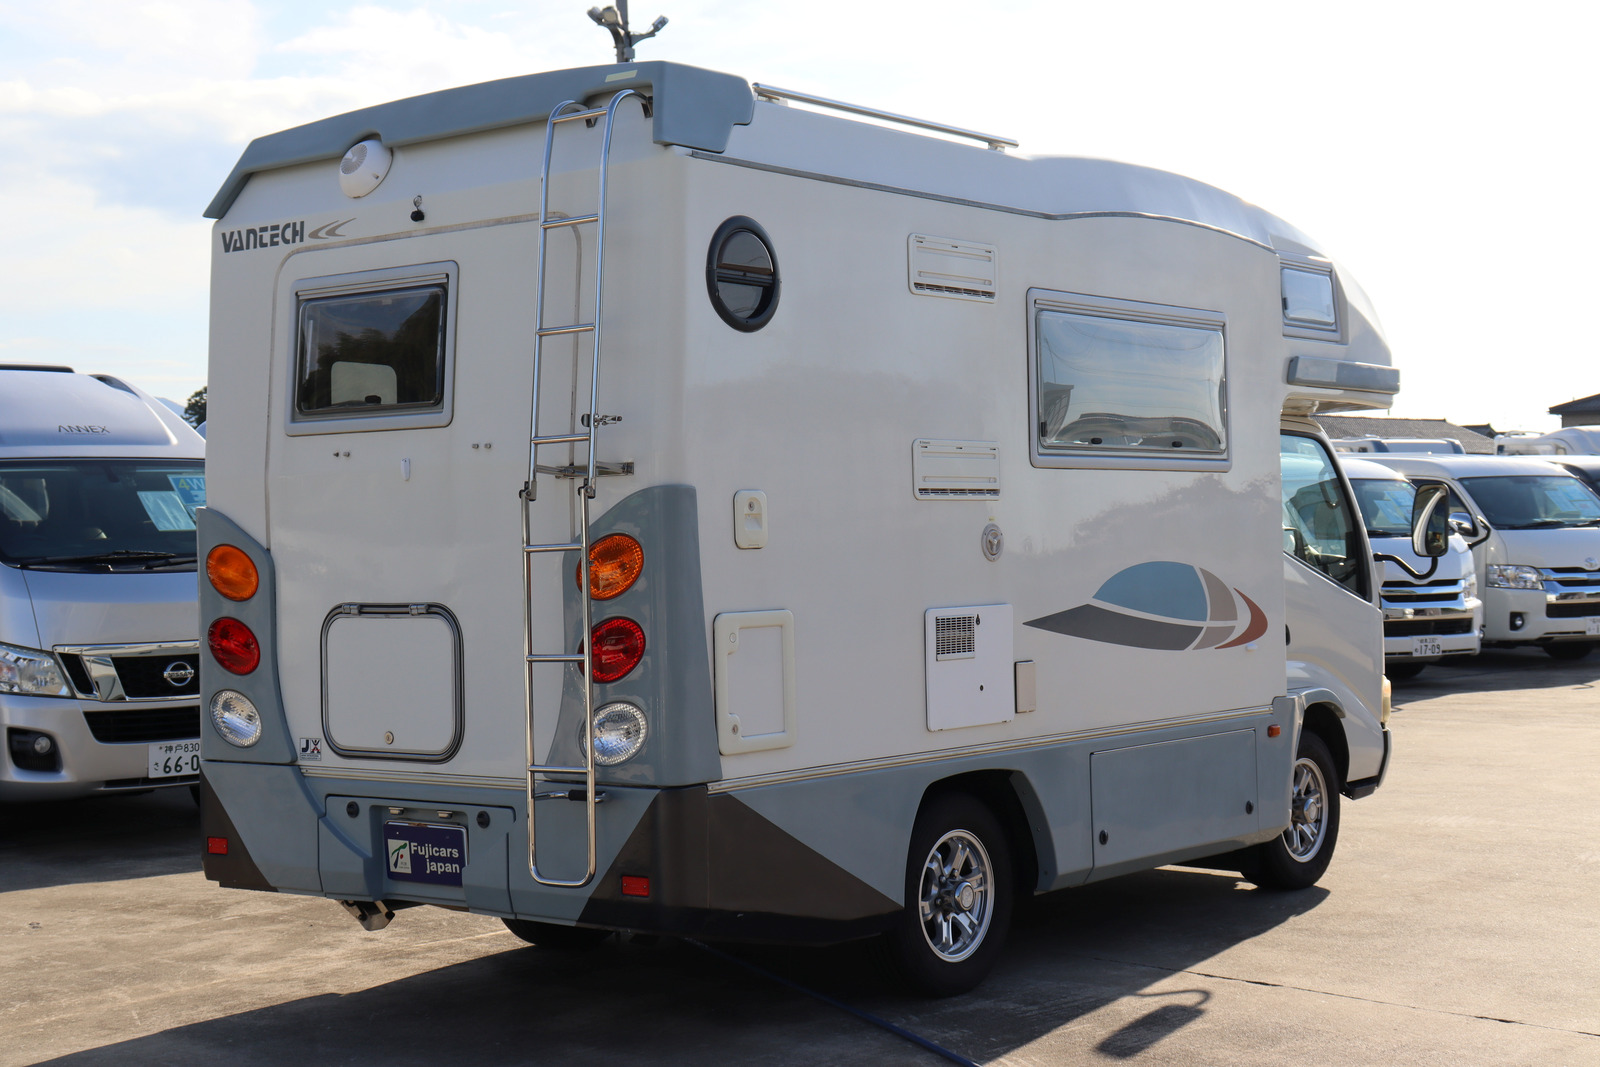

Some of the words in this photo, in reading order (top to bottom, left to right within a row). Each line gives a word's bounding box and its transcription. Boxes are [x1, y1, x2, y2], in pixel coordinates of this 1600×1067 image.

[221, 220, 305, 253] VANTECH
[57, 424, 111, 434] ANNEX
[167, 669, 194, 679] NISSAN
[410, 842, 459, 859] Fujicars
[426, 858, 460, 875] japan
